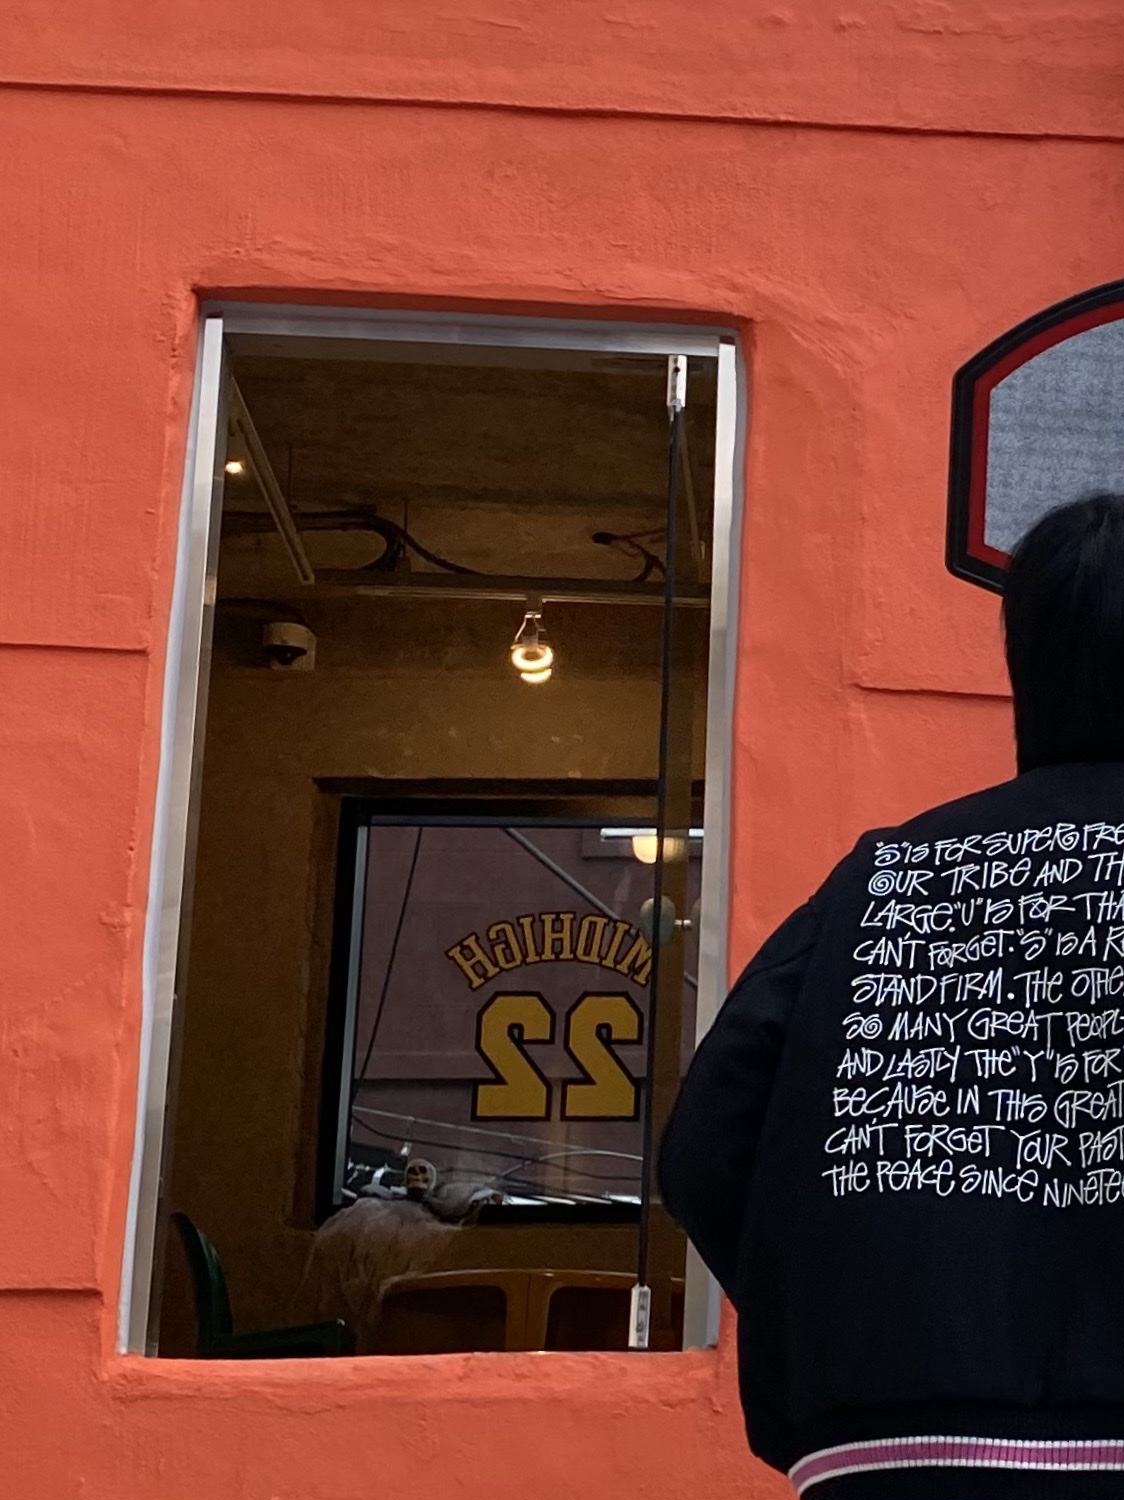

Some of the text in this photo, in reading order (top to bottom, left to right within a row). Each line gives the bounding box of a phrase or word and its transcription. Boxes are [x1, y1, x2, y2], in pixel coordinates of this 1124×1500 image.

[904, 843, 929, 864] IS
[935, 834, 982, 865] FOR
[868, 869, 934, 896] OUR
[1033, 858, 1083, 887] AND
[984, 898, 1014, 925] IS
[1018, 891, 1075, 925] FOR
[853, 931, 926, 969] CAN'T
[1055, 932, 1079, 956] IS
[1078, 926, 1097, 957] A
[851, 973, 938, 1007] STAND
[939, 967, 1015, 1005] FIRM.
[842, 1012, 882, 1040] SO
[888, 1008, 969, 1042] MANY
[836, 1047, 884, 1079] AND
[882, 1045, 961, 1083] LASTLY
[1054, 1053, 1079, 1084] IS
[1082, 1049, 1122, 1083] FOR
[957, 1085, 980, 1115] IN
[987, 1089, 1048, 1123] THIS
[824, 1118, 898, 1156] CAN'T
[1009, 1129, 1072, 1169] YOUR
